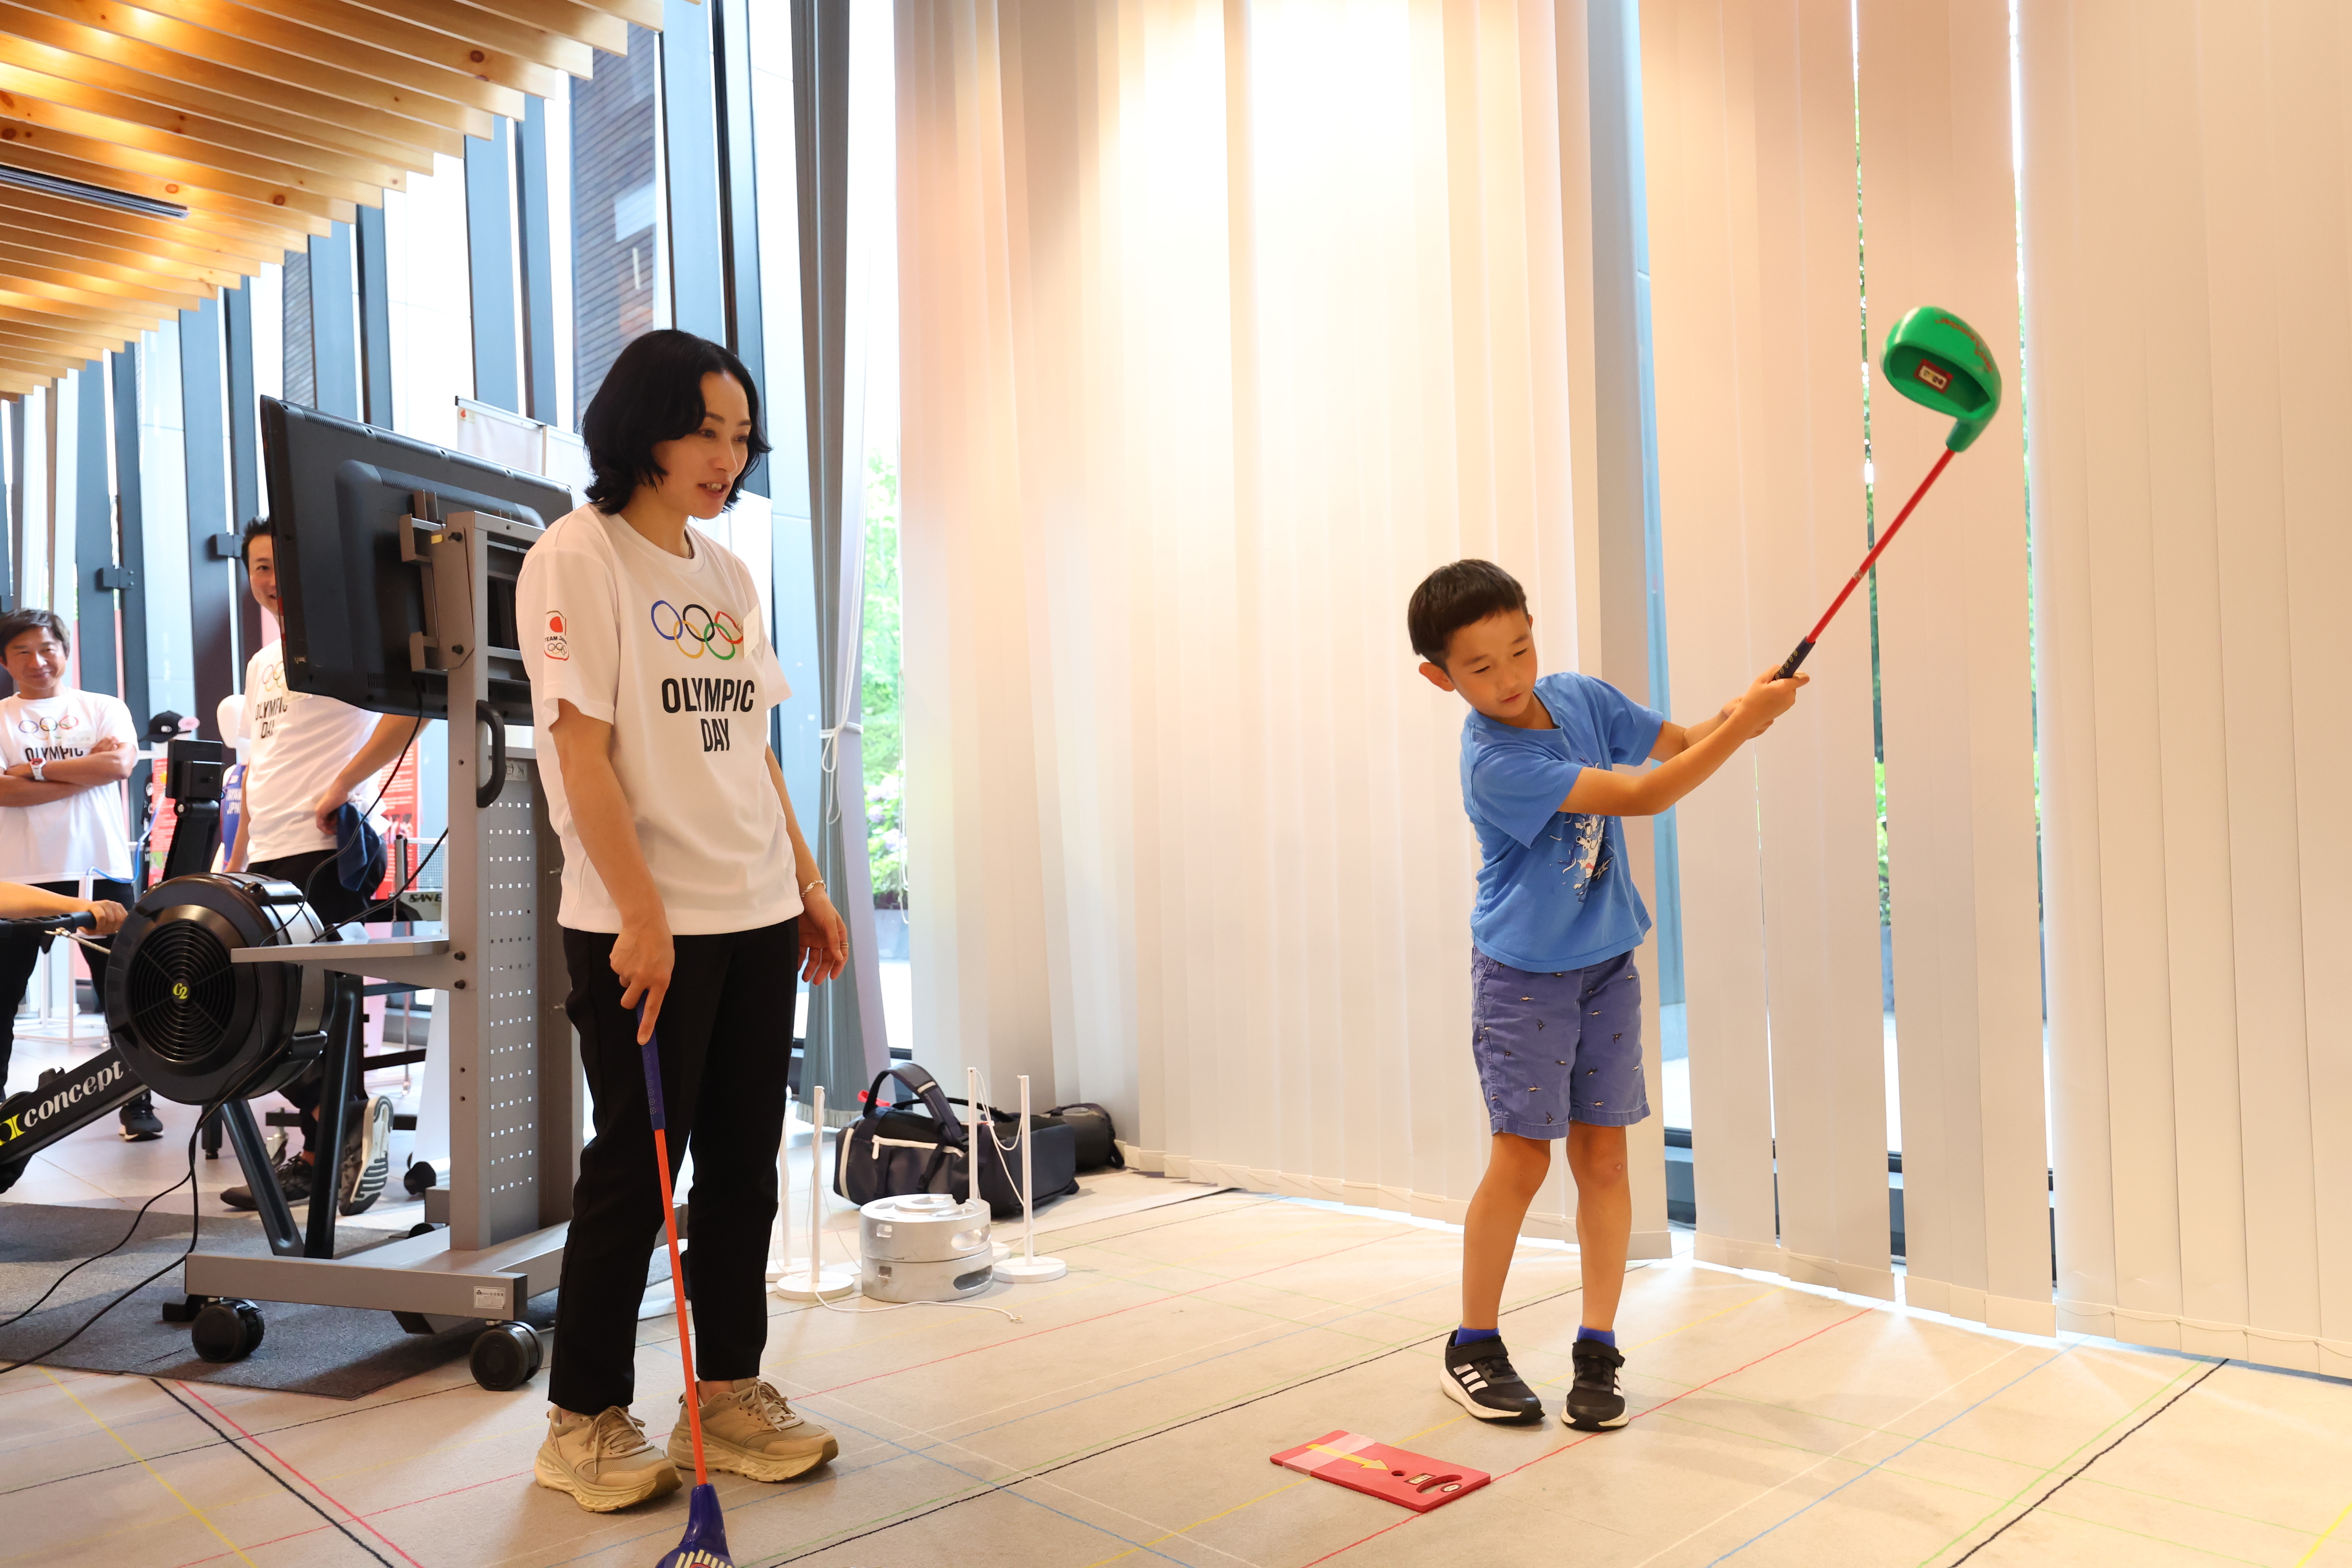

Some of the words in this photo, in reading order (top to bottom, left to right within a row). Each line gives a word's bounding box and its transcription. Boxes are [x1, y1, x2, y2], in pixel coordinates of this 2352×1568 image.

[662, 678, 755, 713] OLYMPIC
[700, 718, 730, 752] DAY
[173, 982, 188, 1000] C2
[24, 1061, 123, 1127] concept
